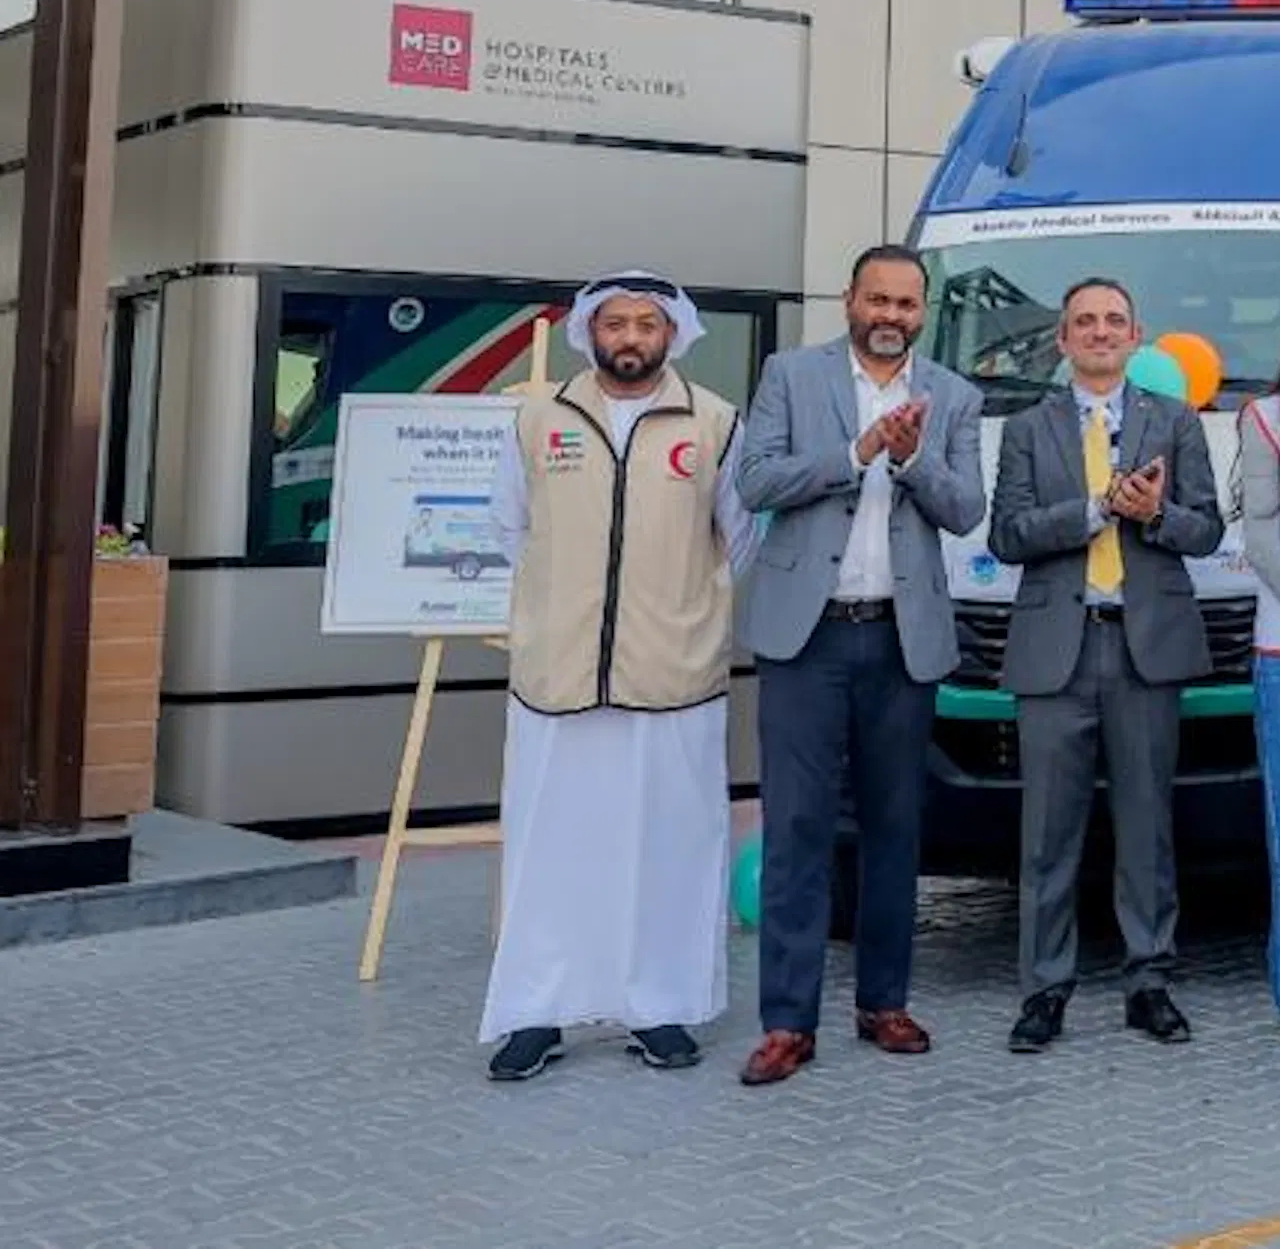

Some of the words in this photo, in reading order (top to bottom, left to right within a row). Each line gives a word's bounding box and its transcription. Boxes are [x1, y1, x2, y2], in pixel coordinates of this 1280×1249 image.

[401, 29, 463, 57] MED
[485, 37, 610, 71] HOSPITALS
[400, 52, 463, 78] CARE
[505, 64, 594, 91] MEDICAL
[396, 420, 460, 443] Making
